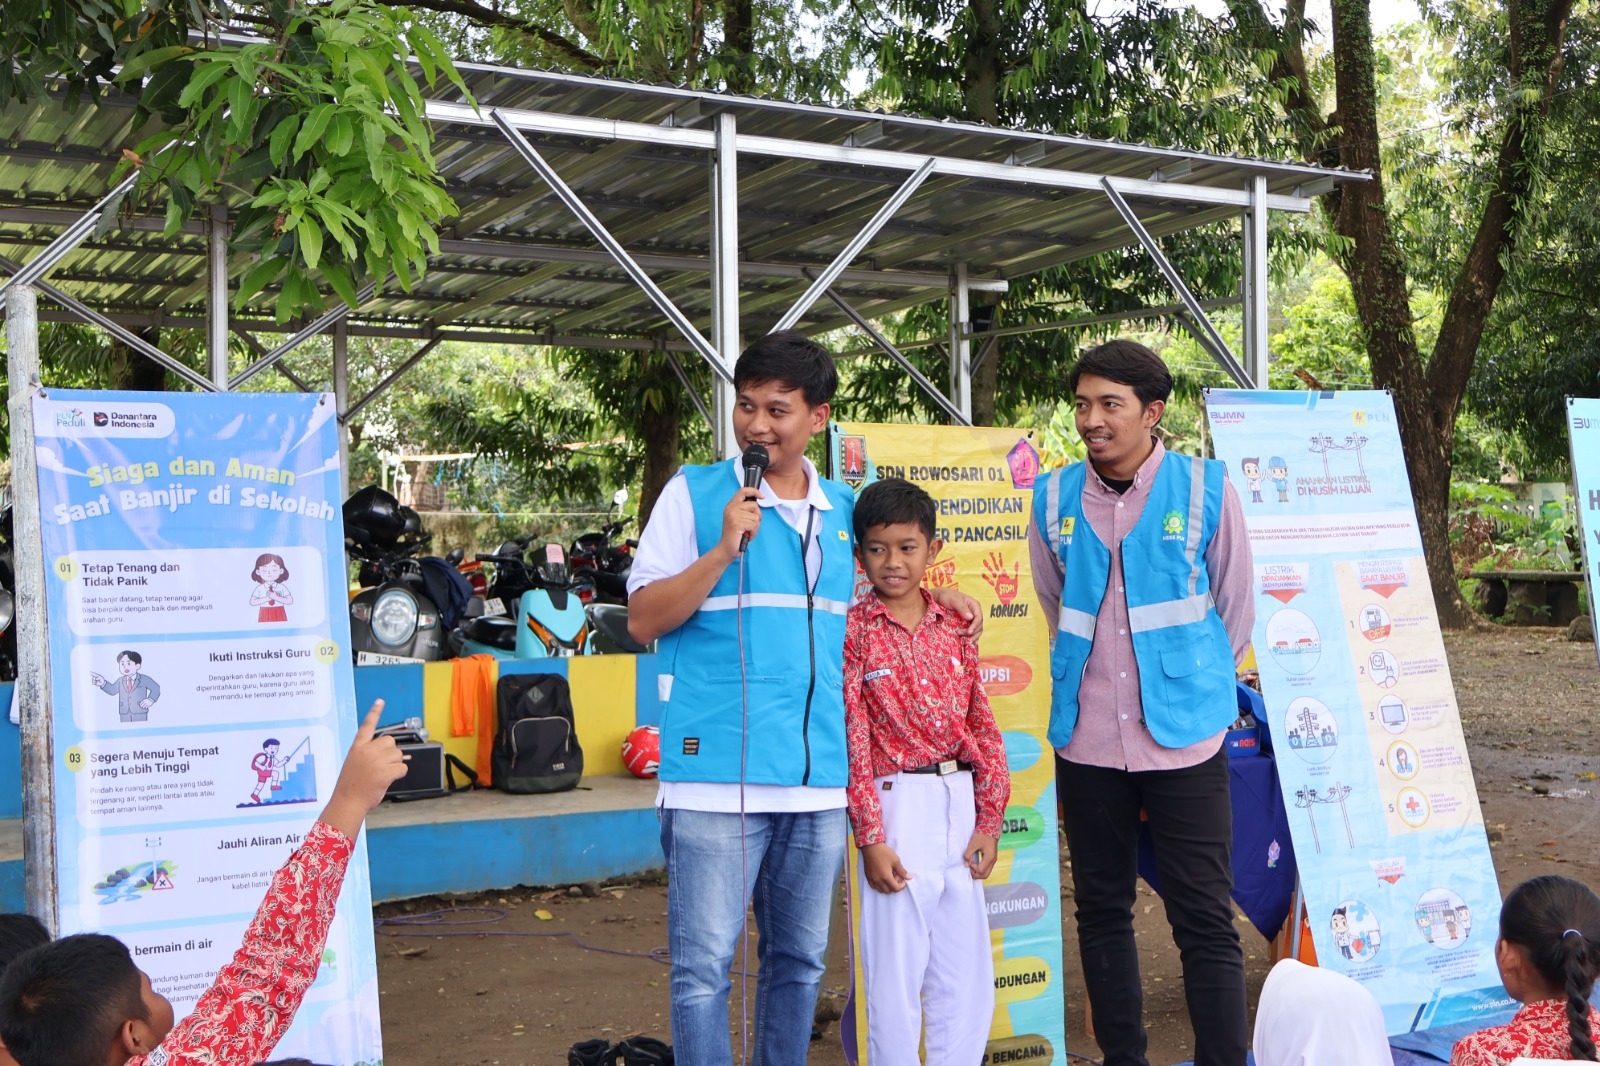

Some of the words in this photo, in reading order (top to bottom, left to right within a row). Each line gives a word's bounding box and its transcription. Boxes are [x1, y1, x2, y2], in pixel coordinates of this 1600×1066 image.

[57, 417, 85, 427] Peduli
[111, 412, 157, 422] Danantara
[1368, 414, 1390, 422] PLN
[112, 420, 154, 429] Indonesia
[1573, 418, 1600, 428] BUM
[86, 460, 159, 487] Siaga
[169, 456, 215, 476] dan
[226, 458, 295, 486] Aman
[876, 465, 905, 480] SDN
[910, 466, 983, 481] ROWOSARI
[989, 468, 1004, 481] 01
[1298, 486, 1306, 496] DI
[54, 494, 111, 525] Saat
[120, 484, 197, 513] Banjir
[208, 484, 230, 505] di
[240, 487, 335, 521] Sekolah
[60, 563, 71, 573] 01
[82, 563, 114, 575] Tetap
[117, 563, 157, 574] Tenang
[160, 563, 180, 572] dan
[1265, 566, 1295, 574] LISTRIK
[922, 561, 956, 590] TOP
[1380, 572, 1405, 581] BANJIR
[83, 577, 114, 587] Tidak
[117, 576, 148, 586] Panik
[99, 596, 118, 604] banjir
[146, 595, 162, 603] tetap
[98, 605, 123, 614] berpikir
[125, 605, 150, 613] dengan
[180, 604, 213, 612] mengikuti
[1350, 620, 1355, 628] 1
[1369, 627, 1385, 640] OFF
[210, 650, 233, 662] Ikuti
[236, 649, 282, 661] Instruksi
[285, 648, 311, 658] Guru
[320, 646, 334, 656] 02
[360, 653, 366, 662] H
[980, 668, 1010, 682] UPSI
[1360, 666, 1365, 674] 2
[209, 673, 243, 683] Dengarkan
[299, 670, 314, 678] yang
[196, 682, 240, 692] diperintahkan
[242, 683, 258, 691] guru,
[260, 680, 282, 689] karena
[210, 692, 243, 701] memandu
[253, 691, 276, 700] tempat
[278, 690, 294, 699] yang
[1370, 712, 1375, 720] 3
[69, 753, 81, 764] 03
[90, 752, 130, 765] Segera
[133, 749, 174, 762] Menuju
[177, 746, 219, 759] Tempat
[1379, 759, 1385, 767] 4
[91, 767, 118, 779] yang
[121, 763, 152, 776] Lebih
[154, 761, 190, 774] Tinggi
[90, 786, 113, 794] Pindah
[125, 785, 145, 794] ruang
[197, 779, 214, 787] tidak
[90, 796, 125, 805] tergenang
[138, 793, 162, 802] seperti
[90, 807, 115, 816] tempat
[1389, 805, 1394, 813] 5
[1002, 818, 1028, 834] OBA
[217, 838, 248, 850] Jauhi
[250, 836, 282, 847] Aliran
[285, 834, 301, 843] Air
[197, 874, 221, 884] Jangan
[223, 872, 250, 882] bermain
[232, 882, 250, 890] kabel
[252, 880, 269, 888] listrik
[986, 896, 1044, 914] NGKUNGAN
[135, 942, 182, 956] bermain
[184, 940, 195, 950] di
[198, 939, 213, 949] air
[180, 972, 203, 980] kuman
[994, 971, 1046, 989] NDUNGAN
[174, 982, 209, 991] kesehatan
[993, 1045, 1046, 1064] BENCANA
